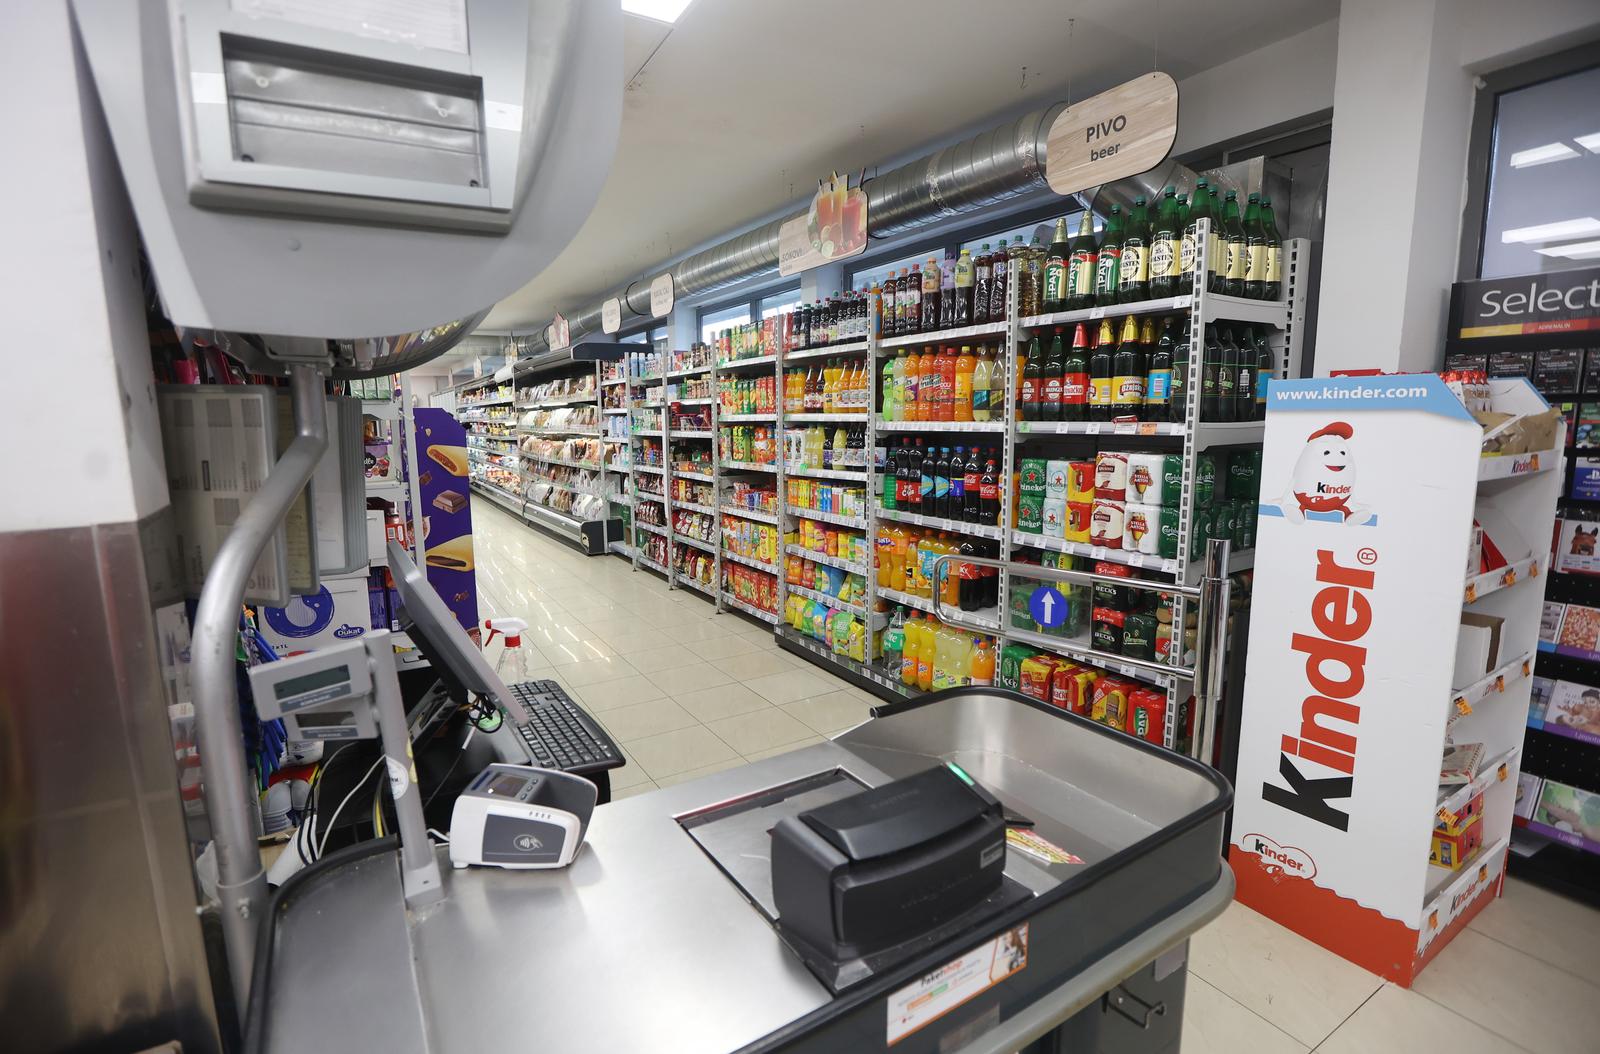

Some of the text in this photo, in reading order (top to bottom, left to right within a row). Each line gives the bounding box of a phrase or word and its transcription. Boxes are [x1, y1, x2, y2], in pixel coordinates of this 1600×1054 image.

[1085, 114, 1127, 143] PIVO
[1090, 142, 1121, 162] beer
[1276, 386, 1428, 400] www.kinder.com
[1020, 484, 1046, 492] eineken
[337, 627, 361, 637] Dukat
